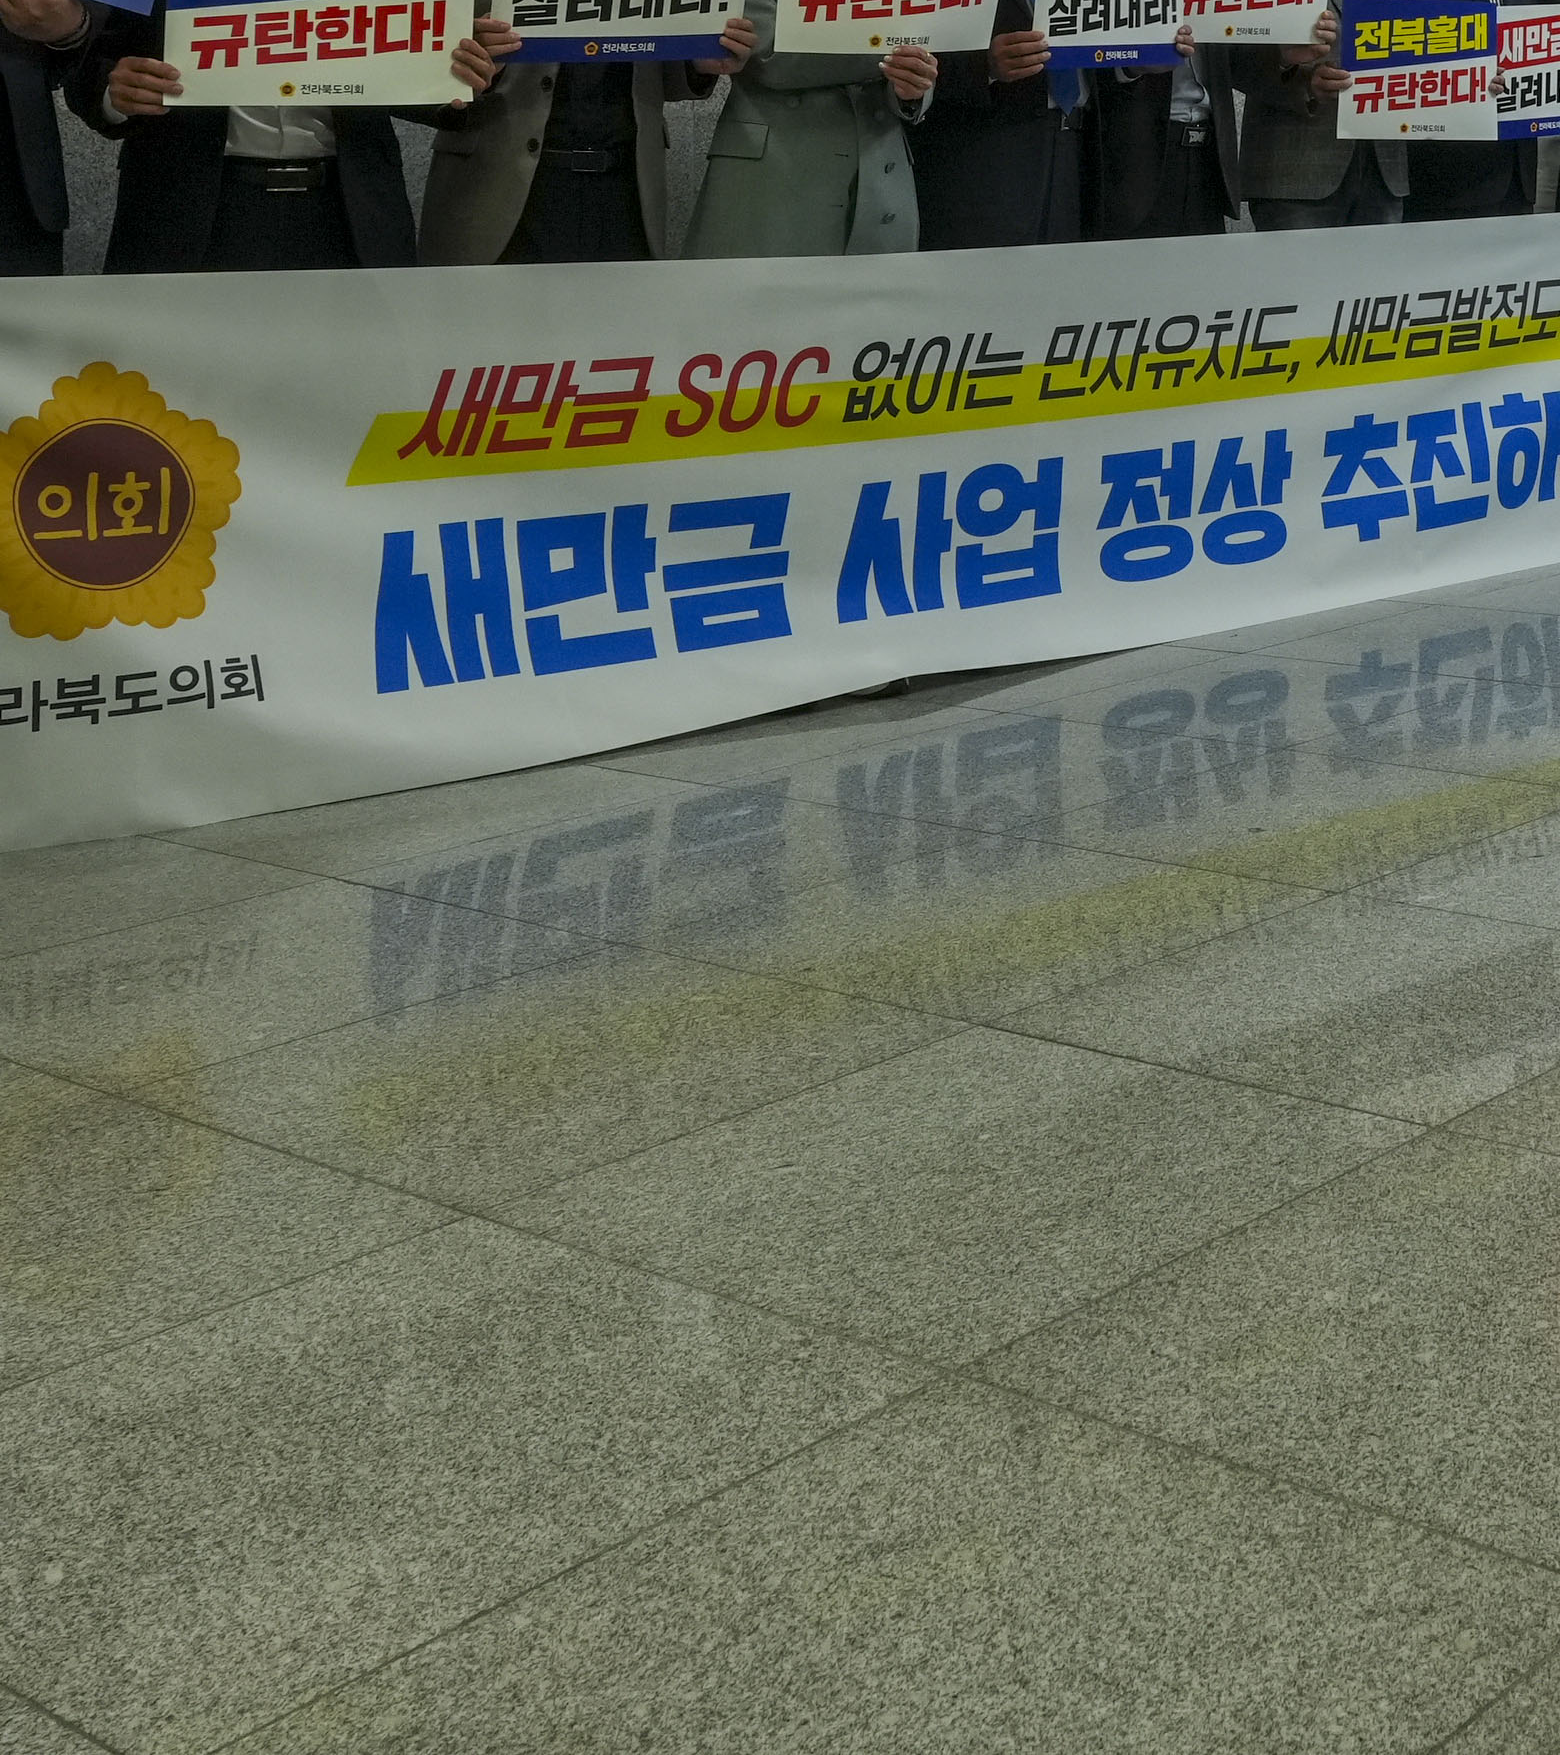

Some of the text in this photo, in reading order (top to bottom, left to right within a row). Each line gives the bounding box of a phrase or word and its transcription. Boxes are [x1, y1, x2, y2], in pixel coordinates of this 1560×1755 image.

[191, 0, 446, 69] 규탄한다!
[885, 35, 931, 47] 전라북도의회
[1235, 26, 1271, 37] 전라북도의회
[1354, 12, 1488, 61] 전북홀대
[601, 42, 656, 56] 전라북도의회
[1105, 49, 1139, 62] 전라북도의회
[300, 83, 364, 96] 전라북도의회
[1352, 66, 1486, 115] 규탄한다!
[1411, 124, 1446, 133] 전라북도의회
[397, 355, 656, 460] 새만금
[664, 346, 831, 440] SOC
[841, 331, 1024, 424] 없이는
[1038, 304, 1302, 402] 민자유치도,
[34, 466, 171, 543] 의회
[375, 493, 792, 695] 새만금
[837, 457, 1063, 625] 사업
[1096, 427, 1292, 583] 정상
